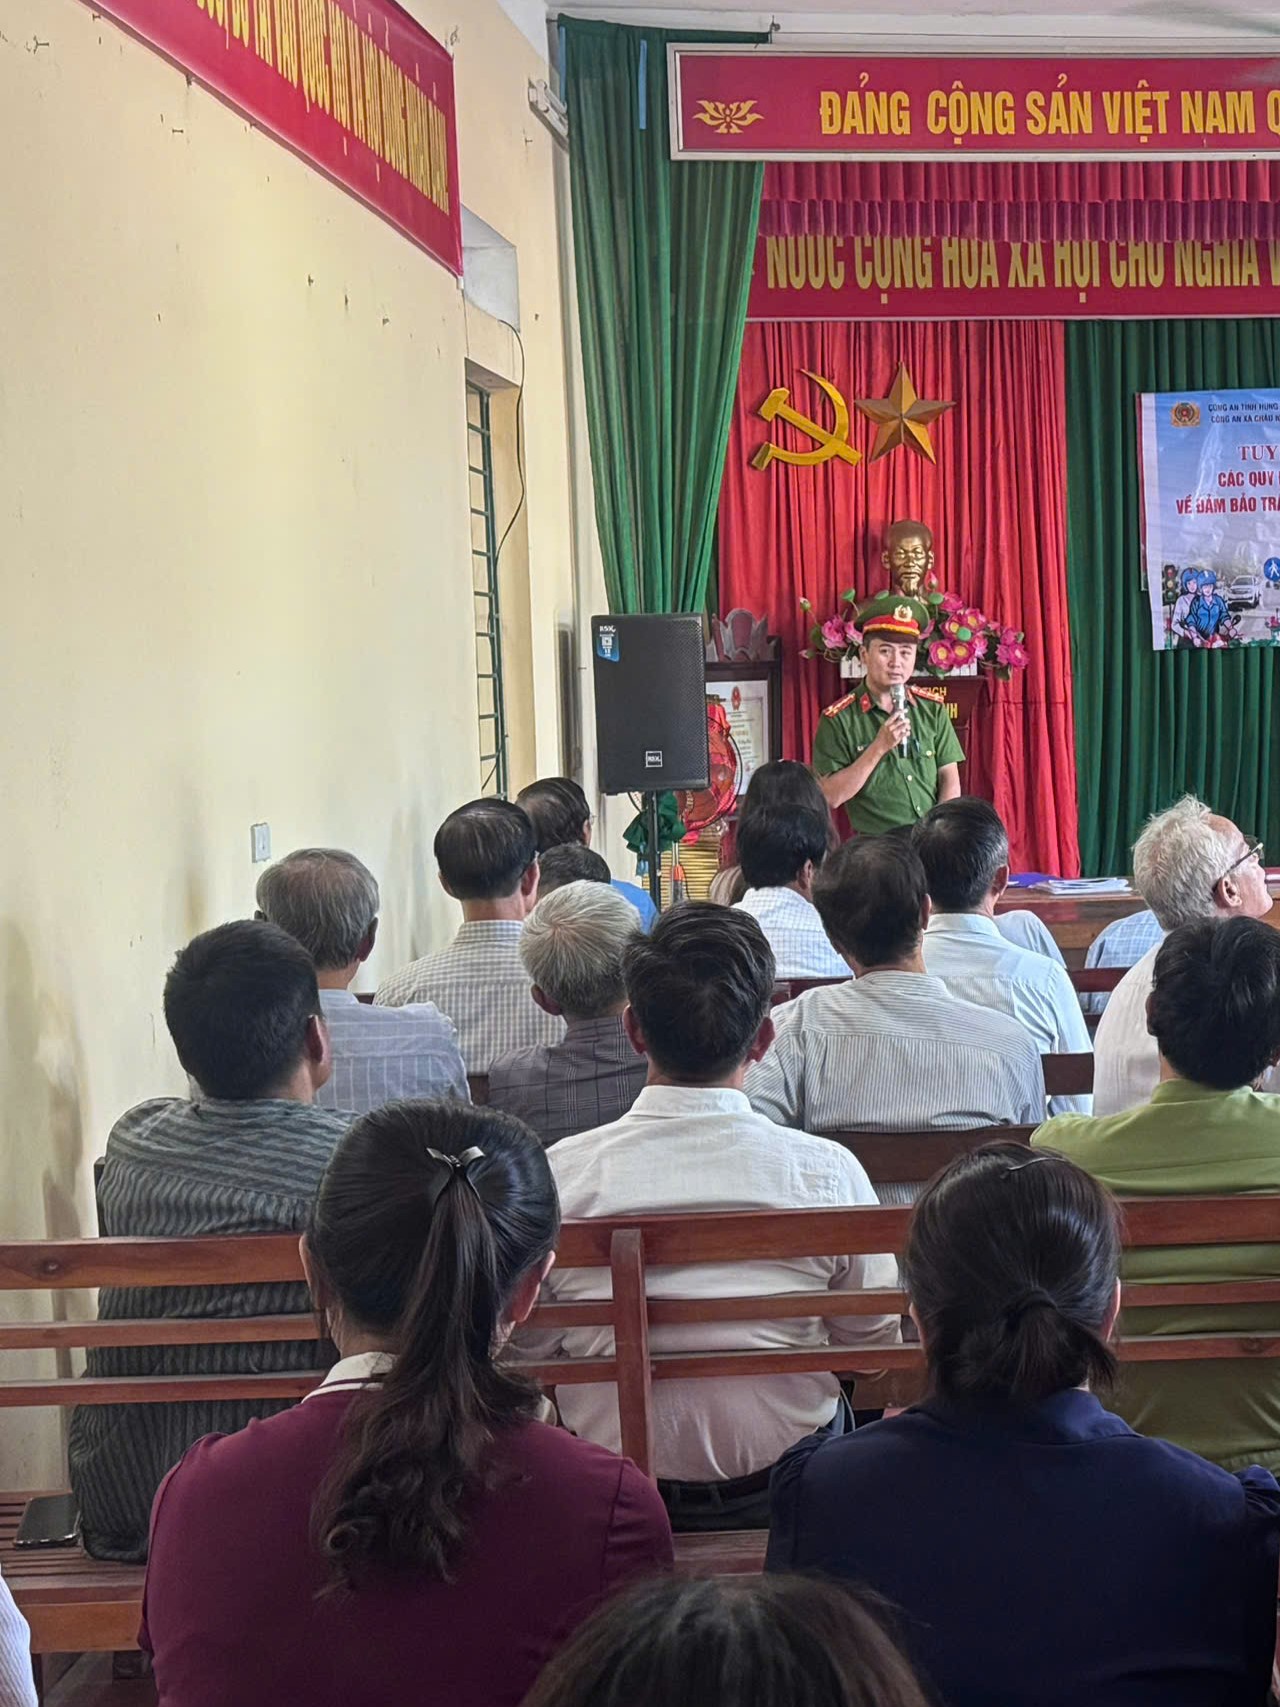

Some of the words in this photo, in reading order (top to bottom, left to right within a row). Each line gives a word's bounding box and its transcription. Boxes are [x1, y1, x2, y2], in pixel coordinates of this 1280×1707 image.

[819, 72, 911, 135] ĐẢNG
[926, 80, 1015, 145] CỘNG
[1025, 73, 1093, 135] SẢN
[1102, 79, 1169, 144] VIỆT
[1181, 90, 1256, 135] NAM
[1218, 469, 1245, 488] CÁC
[1248, 470, 1274, 488] QUY
[1195, 493, 1226, 514] ĐẢM
[1230, 492, 1257, 513] BẢO
